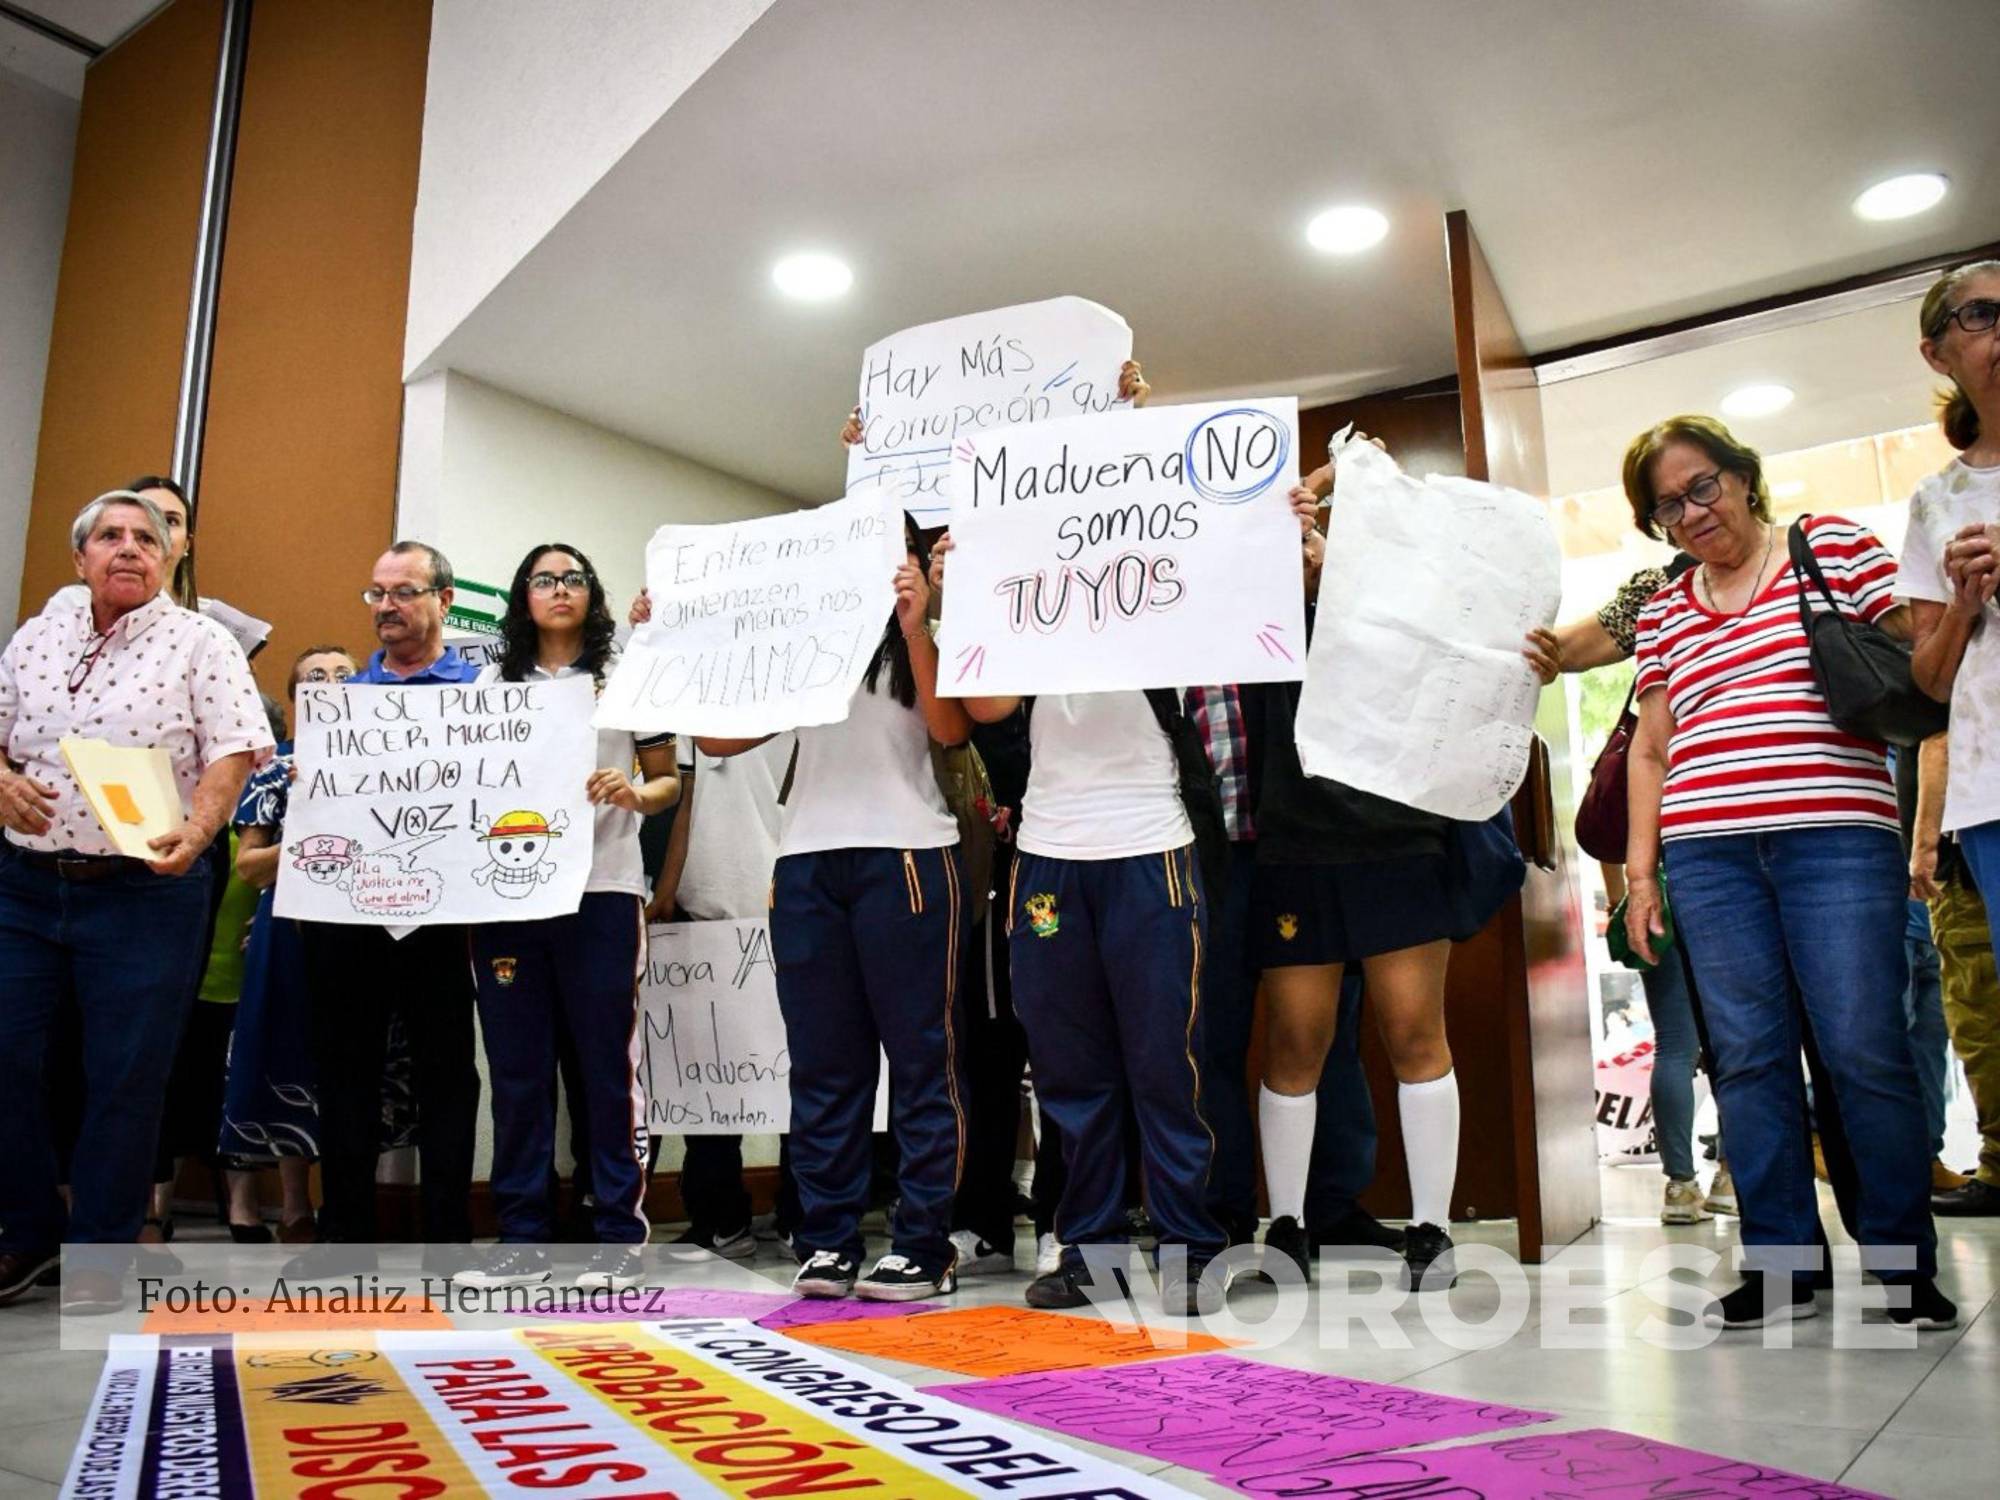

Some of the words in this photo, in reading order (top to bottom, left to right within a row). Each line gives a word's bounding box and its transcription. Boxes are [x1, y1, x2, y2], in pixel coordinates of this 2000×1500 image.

[866, 351, 941, 400] Hay
[974, 444, 1184, 508] Madueña
[1207, 424, 1279, 481] NO
[674, 531, 768, 585] Entre
[996, 552, 1187, 634] TUYOS
[442, 615, 459, 627] UTA
[374, 690, 419, 722] SE
[439, 685, 545, 718] PUEDE
[447, 718, 532, 747] MUCHO
[309, 759, 462, 800] ALZANDO
[476, 757, 522, 790] LA
[1594, 1089, 1633, 1130] EL
[415, 1358, 570, 1425] PARA
[695, 1338, 963, 1435] CONGRESO
[901, 1435, 1081, 1490] DEL
[158, 1394, 218, 1456] NUESTROS
[470, 1423, 648, 1489] LAS
